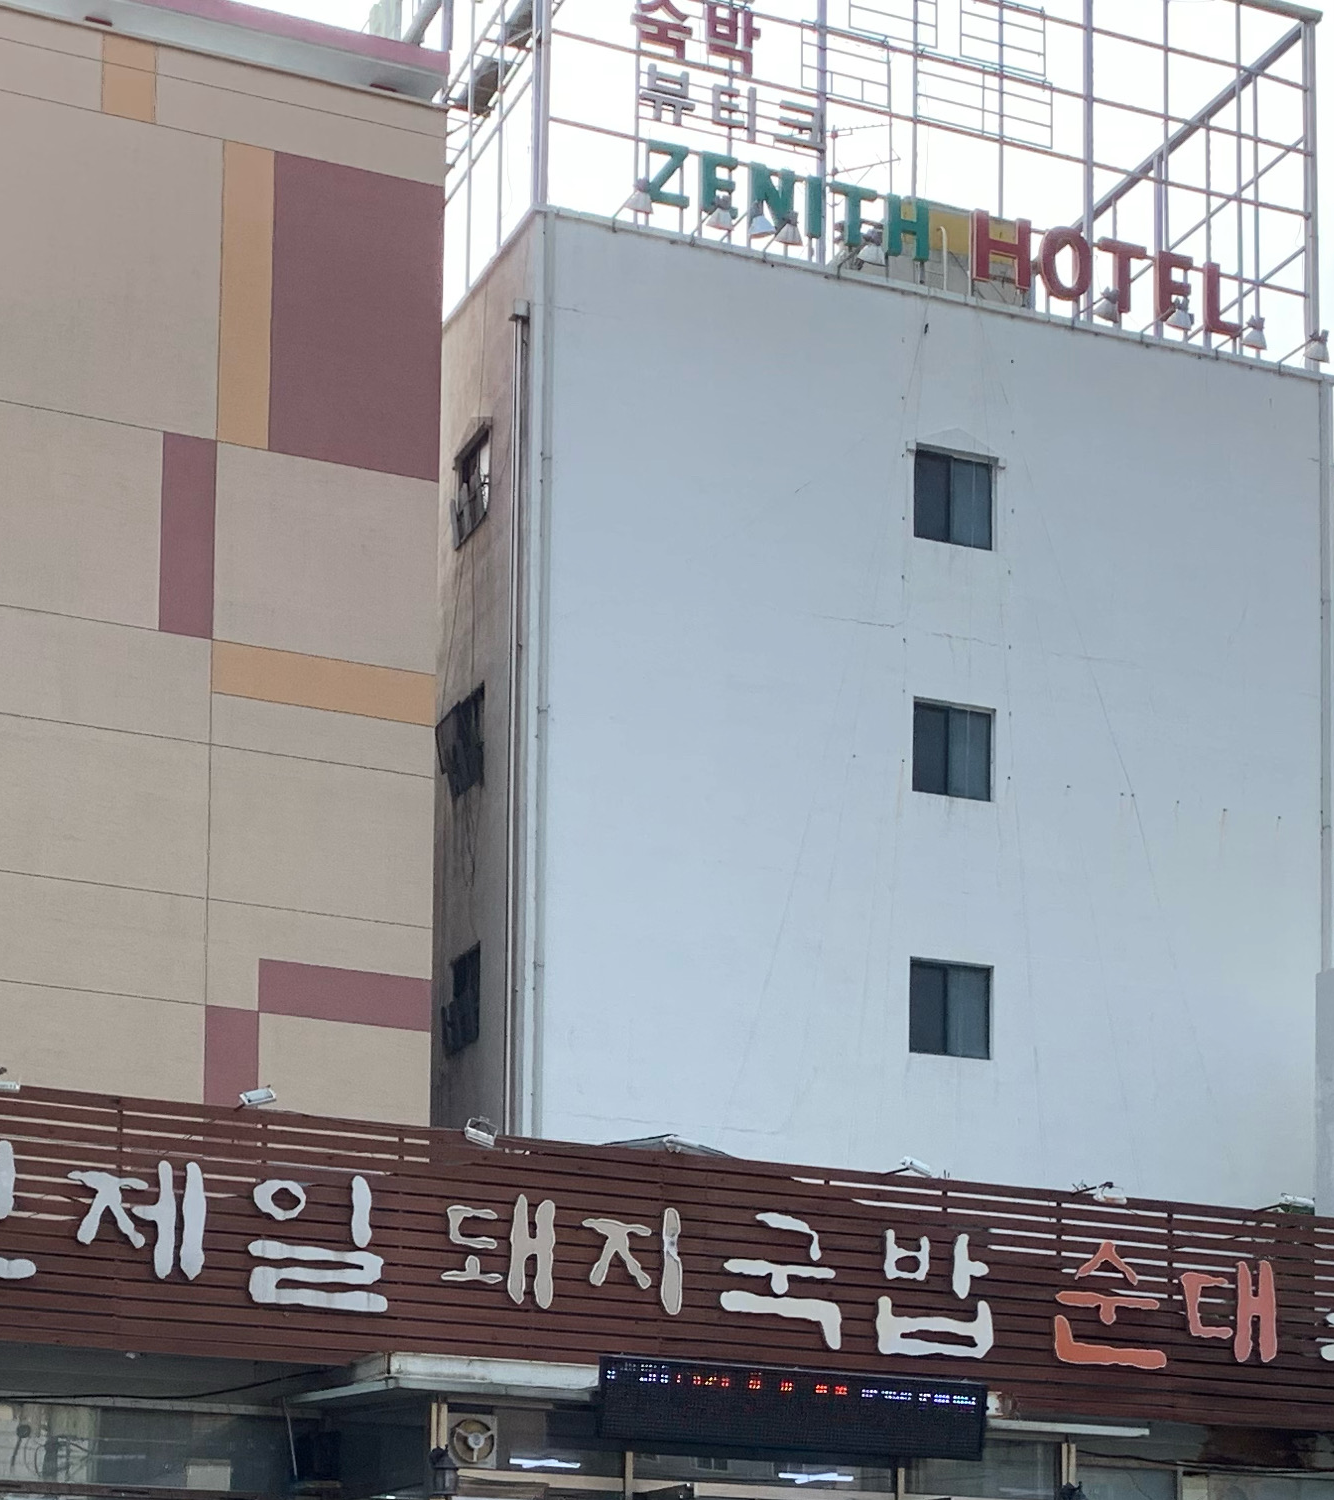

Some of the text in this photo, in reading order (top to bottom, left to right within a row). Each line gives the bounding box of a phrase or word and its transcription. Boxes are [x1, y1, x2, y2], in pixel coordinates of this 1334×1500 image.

[631, 0, 761, 78] 숙박
[639, 63, 827, 152] 뷰티크
[647, 139, 1243, 338] ZENITH HOTEL
[440, 1194, 995, 1359] 돼지국밥
